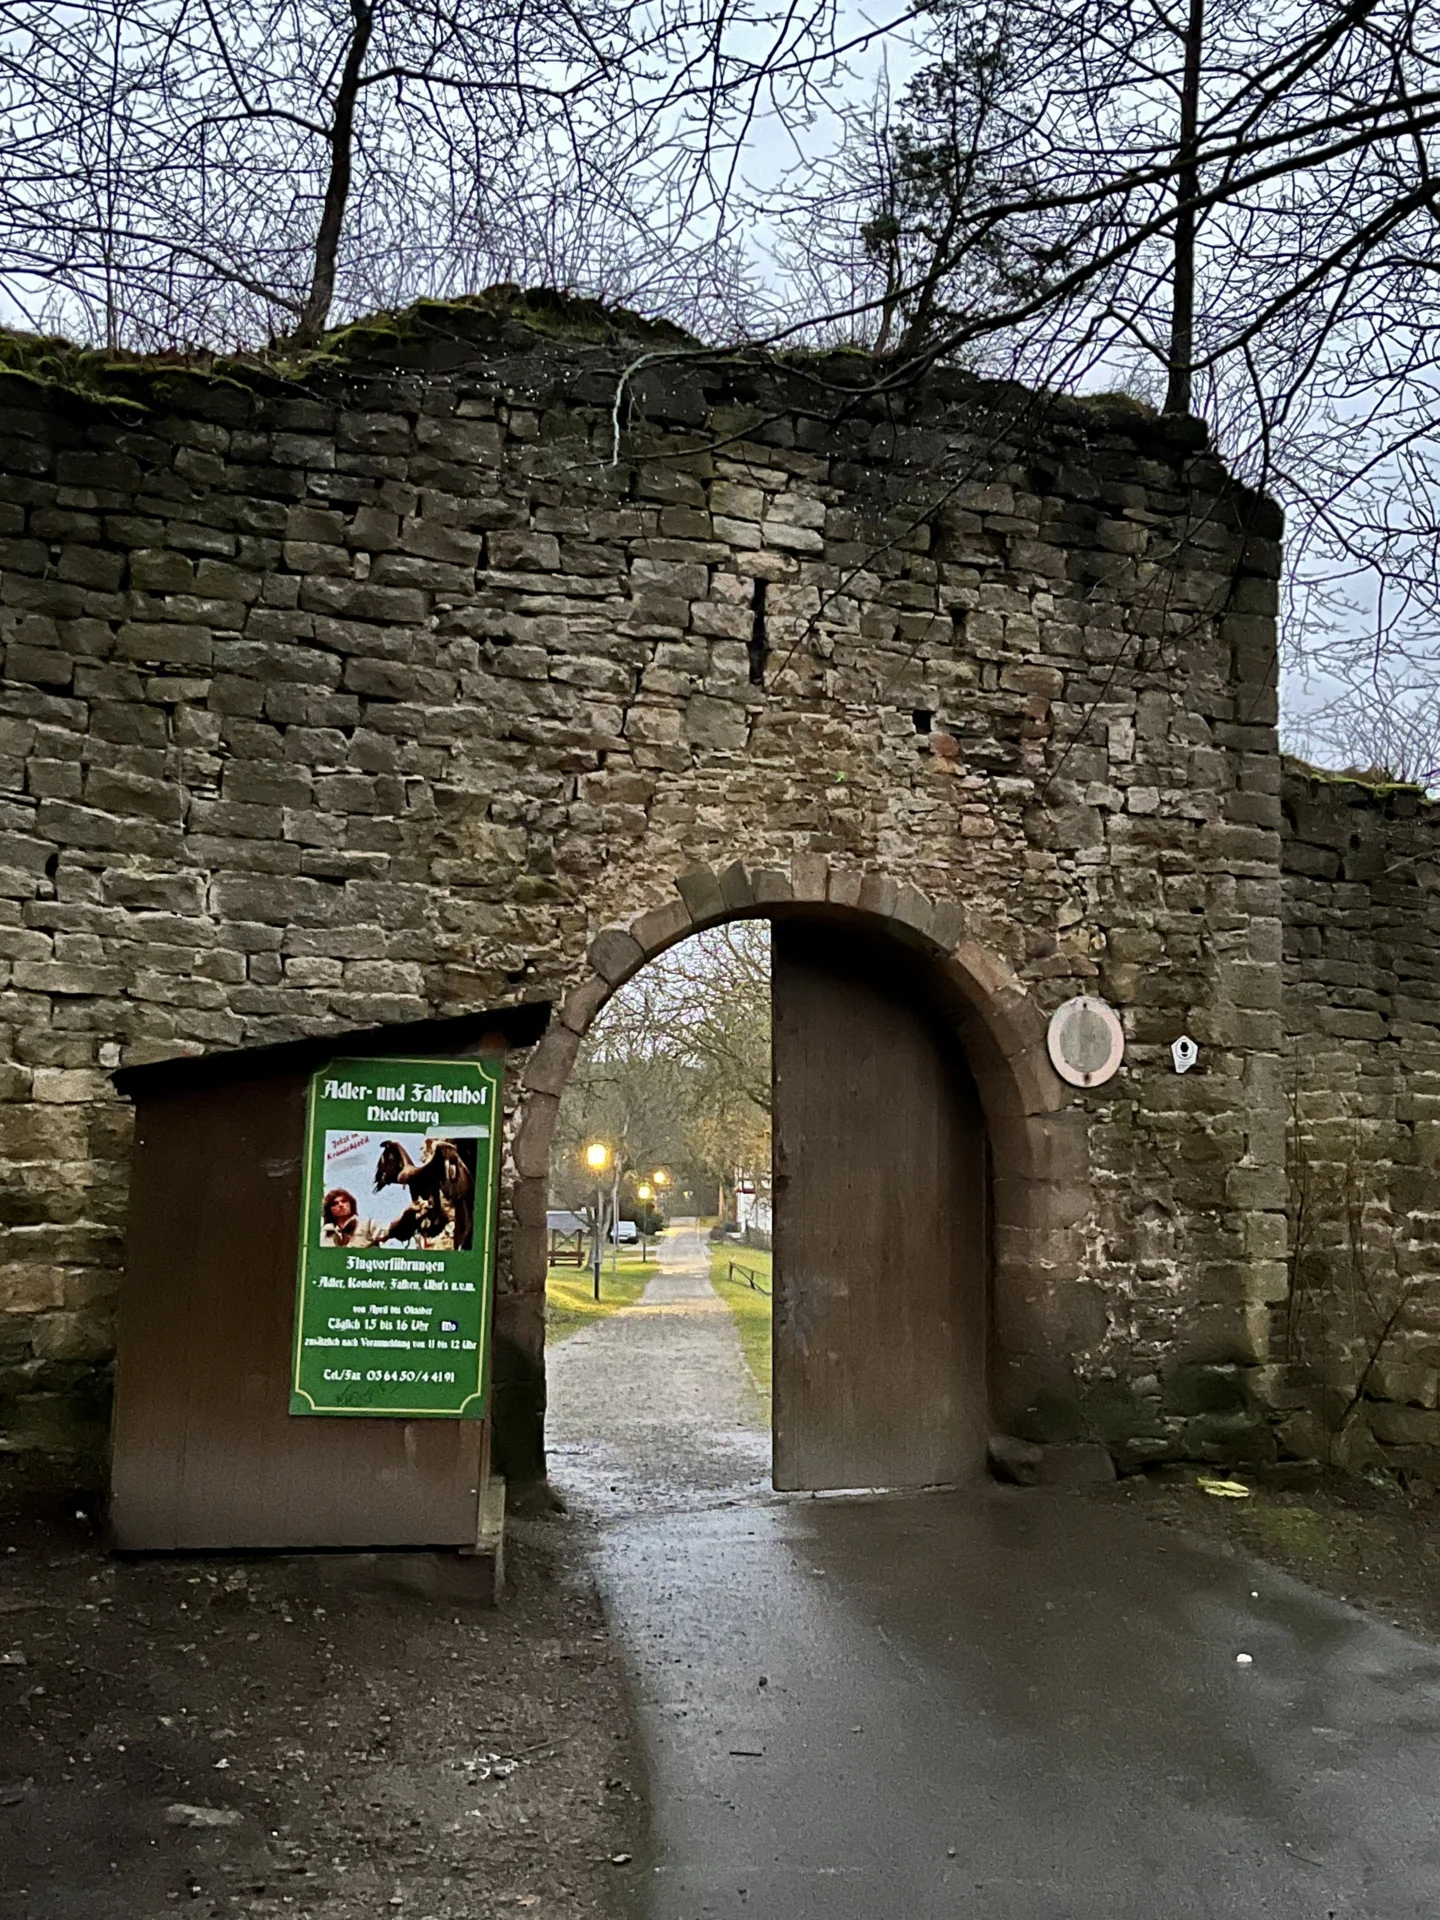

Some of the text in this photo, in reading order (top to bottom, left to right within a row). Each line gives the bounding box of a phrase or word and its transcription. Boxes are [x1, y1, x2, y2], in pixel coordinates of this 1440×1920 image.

[320, 1080, 488, 1105] Adler- und Falkenhof
[367, 1106, 440, 1126] Niederburg
[346, 1256, 445, 1274] Flugvorführungen
[352, 1306, 366, 1314] von
[368, 1304, 389, 1315] April
[403, 1305, 433, 1315] Oktober
[327, 1318, 361, 1331] Täglich
[364, 1319, 377, 1330] 15
[379, 1319, 393, 1331] bis
[396, 1320, 408, 1331] 16
[411, 1320, 430, 1331] Uhr
[450, 1339, 461, 1350] 12
